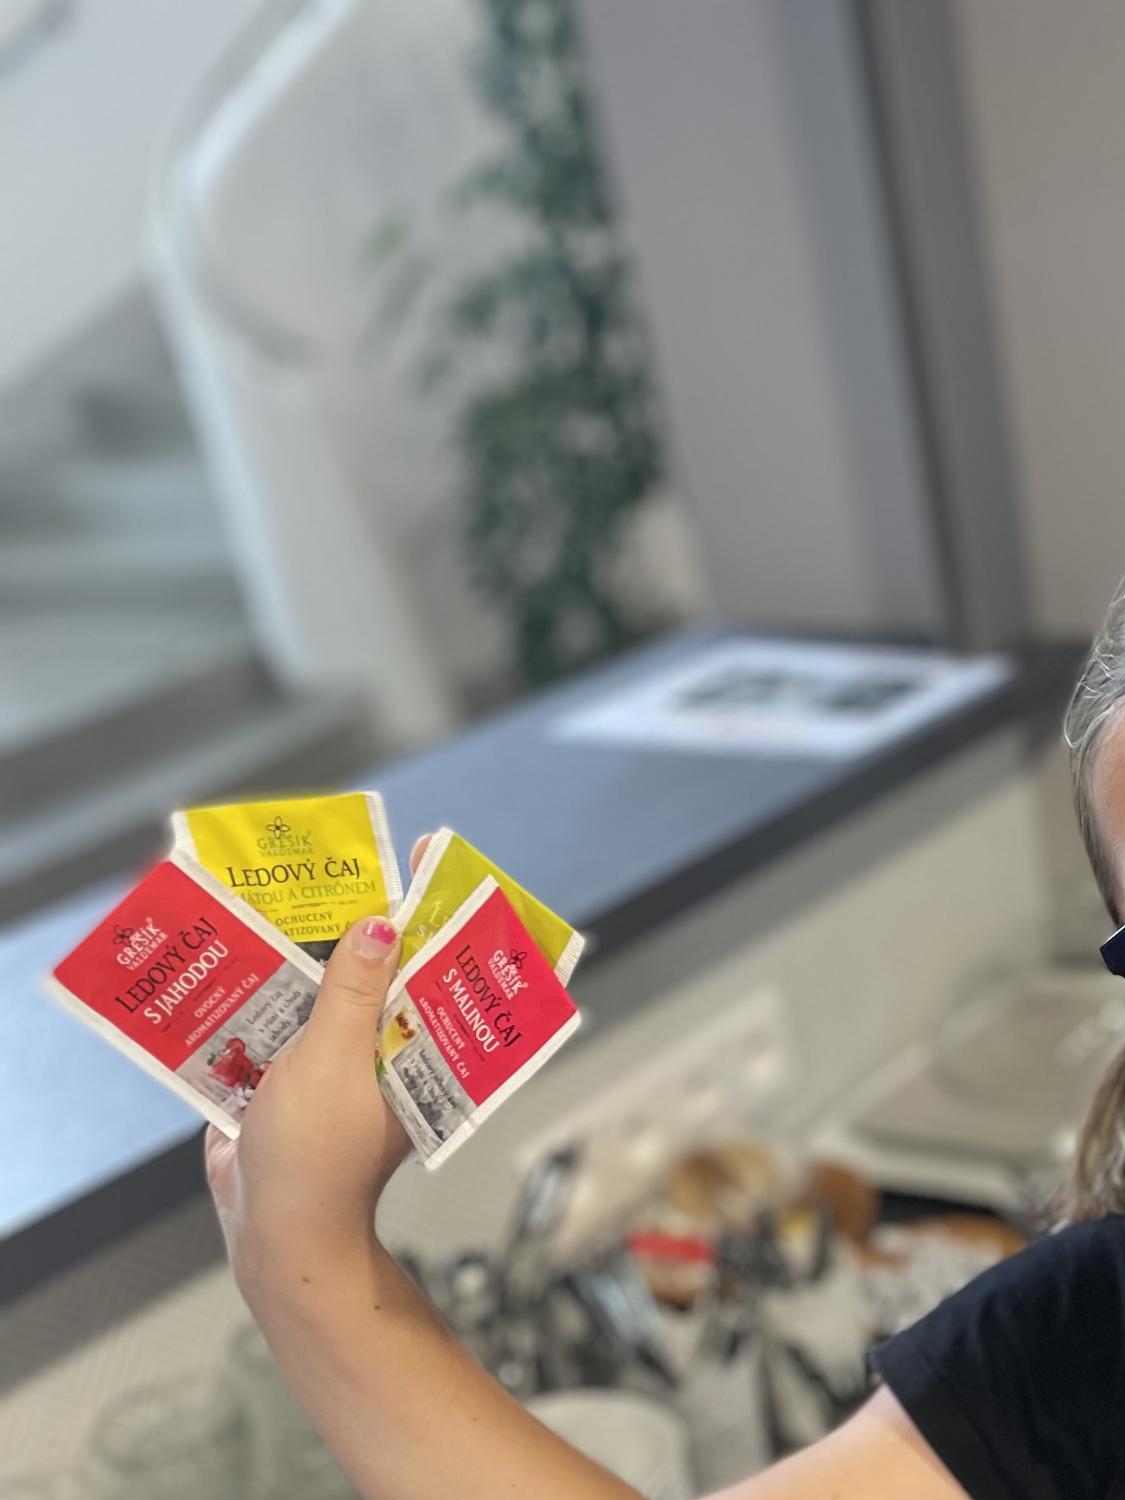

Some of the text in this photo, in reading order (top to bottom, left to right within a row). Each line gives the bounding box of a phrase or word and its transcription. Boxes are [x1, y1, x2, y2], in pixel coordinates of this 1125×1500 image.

[226, 857, 361, 888] LEDOVÝ ČAJ
[240, 888, 284, 906] ÁTOU
[288, 889, 299, 902] A
[115, 916, 218, 1013] LEDOVÝ ČAJ
[144, 939, 229, 1024] S JAHODOU
[455, 944, 522, 1047] LEDOVÝ ČAJ
[442, 968, 500, 1053] S MALINOU
